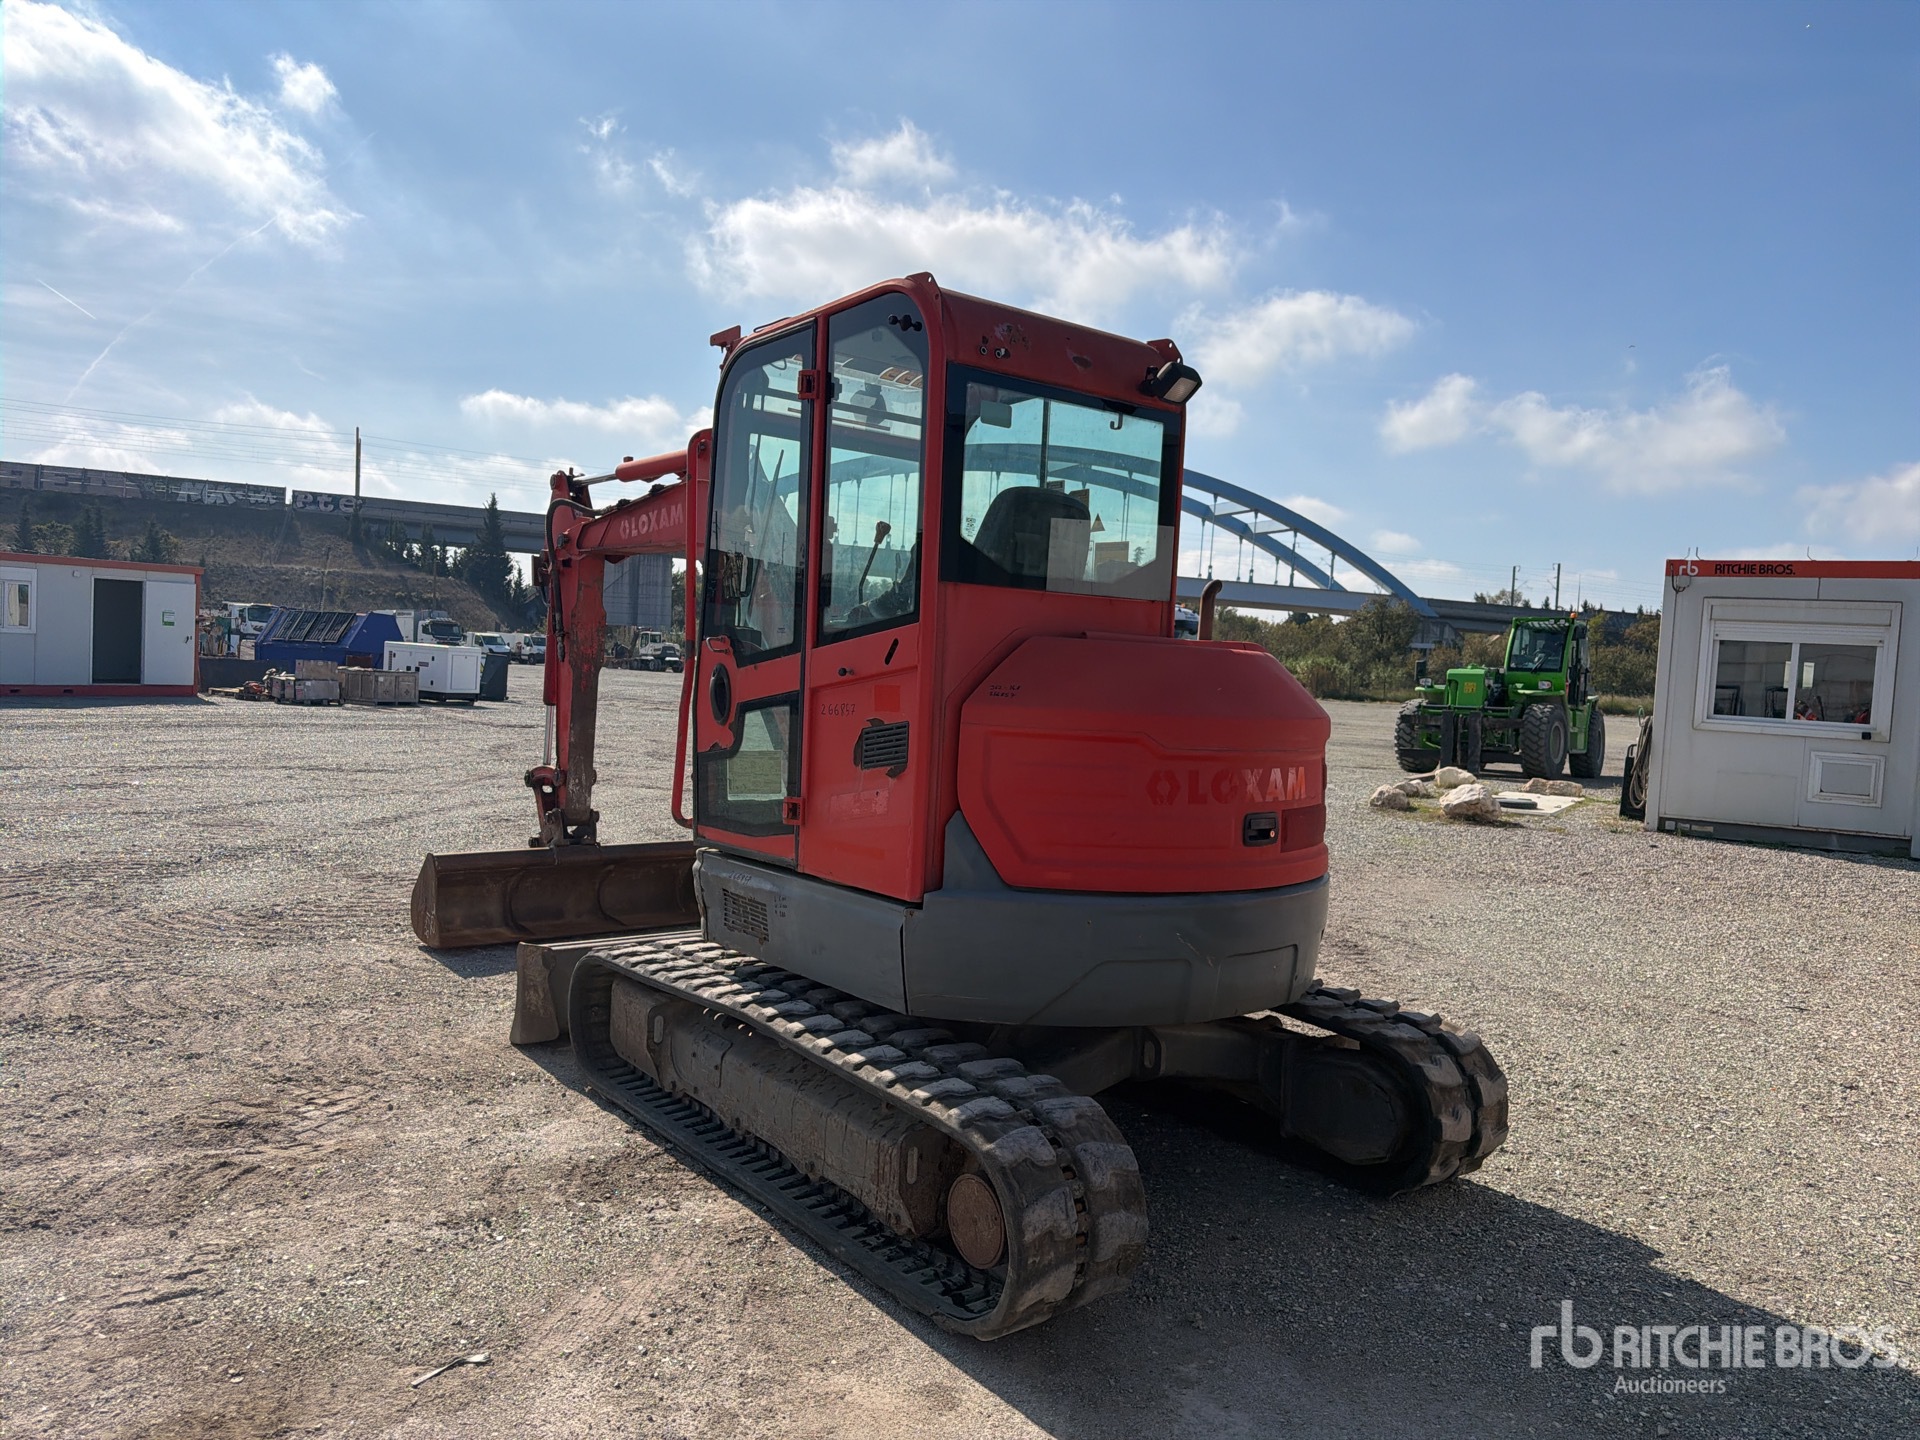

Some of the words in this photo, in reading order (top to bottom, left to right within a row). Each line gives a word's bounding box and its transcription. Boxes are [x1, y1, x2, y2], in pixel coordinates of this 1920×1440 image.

[1679, 560, 1699, 576] rb
[1715, 563, 1757, 575] RITCHIE
[1758, 564, 1796, 576] BROS.
[821, 703, 856, 717] 266857
